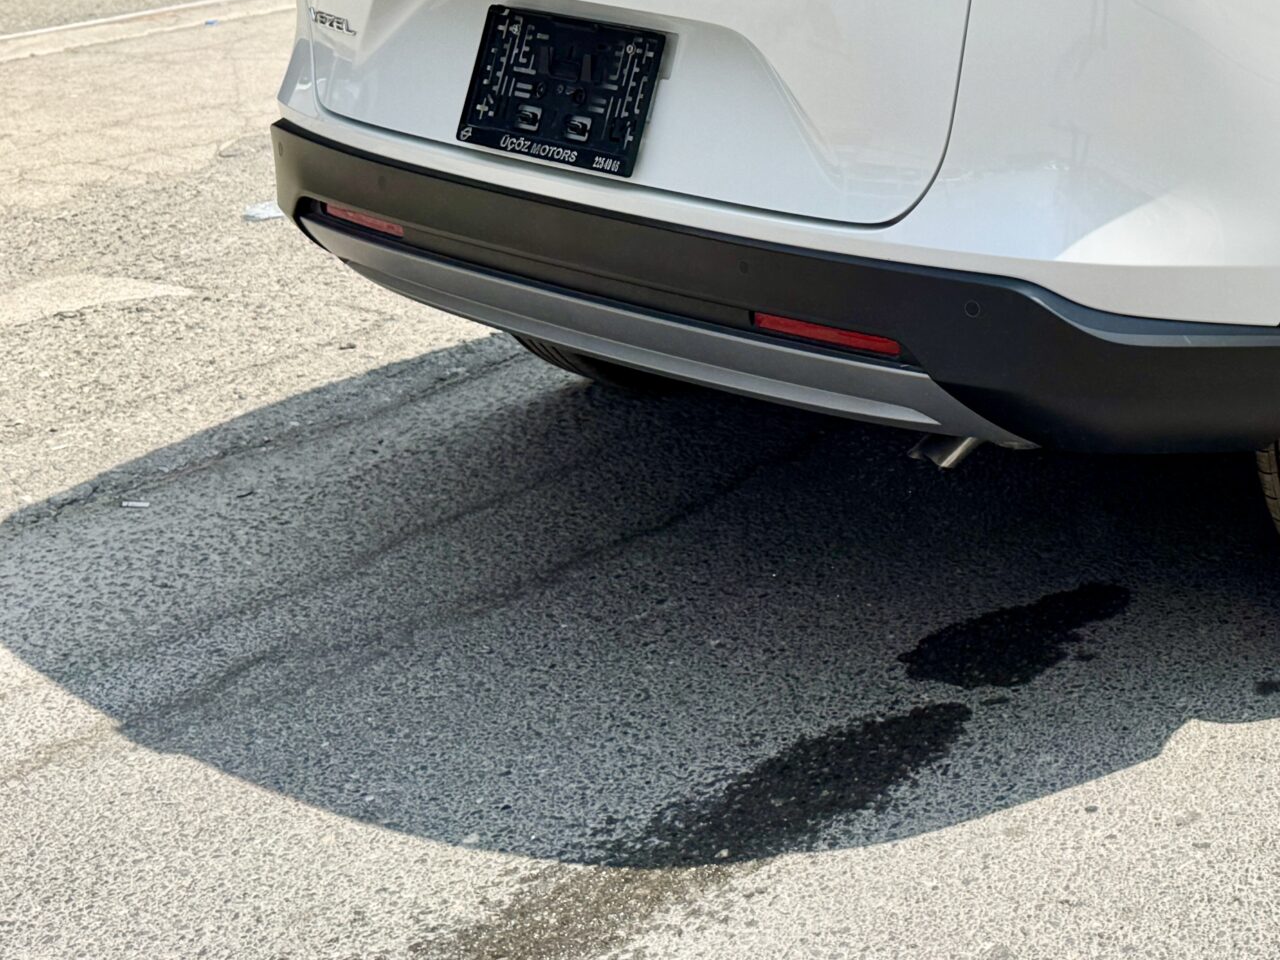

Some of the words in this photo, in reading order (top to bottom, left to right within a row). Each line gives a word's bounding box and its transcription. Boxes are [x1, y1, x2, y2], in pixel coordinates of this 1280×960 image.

[309, 7, 357, 36] VEZEL
[500, 135, 531, 152] ÜÇÖZ
[531, 143, 578, 162] MOTORS
